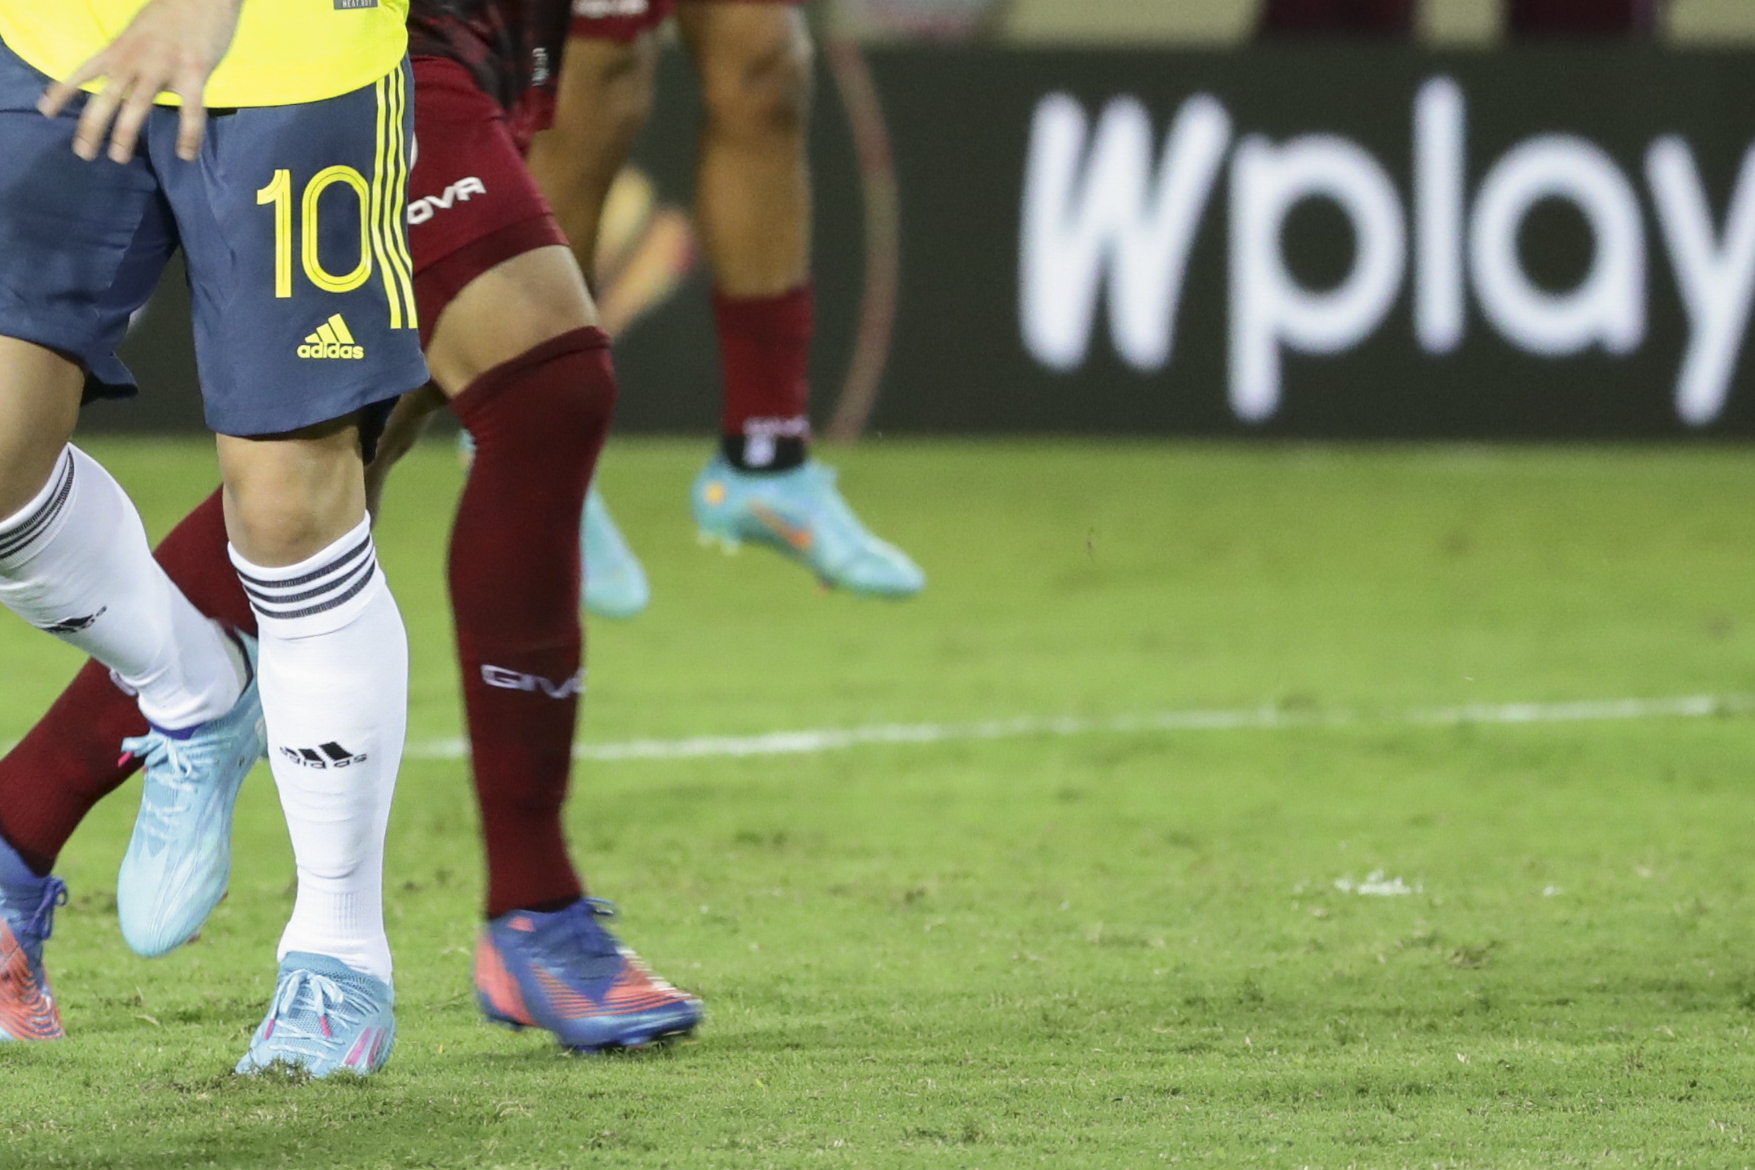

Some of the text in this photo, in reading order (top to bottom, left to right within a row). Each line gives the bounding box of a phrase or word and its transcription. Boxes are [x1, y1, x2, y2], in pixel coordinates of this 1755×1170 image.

[256, 164, 373, 298] 10
[407, 176, 487, 225] OVA
[1018, 74, 1755, 426] Wplay
[297, 342, 364, 360] adidas
